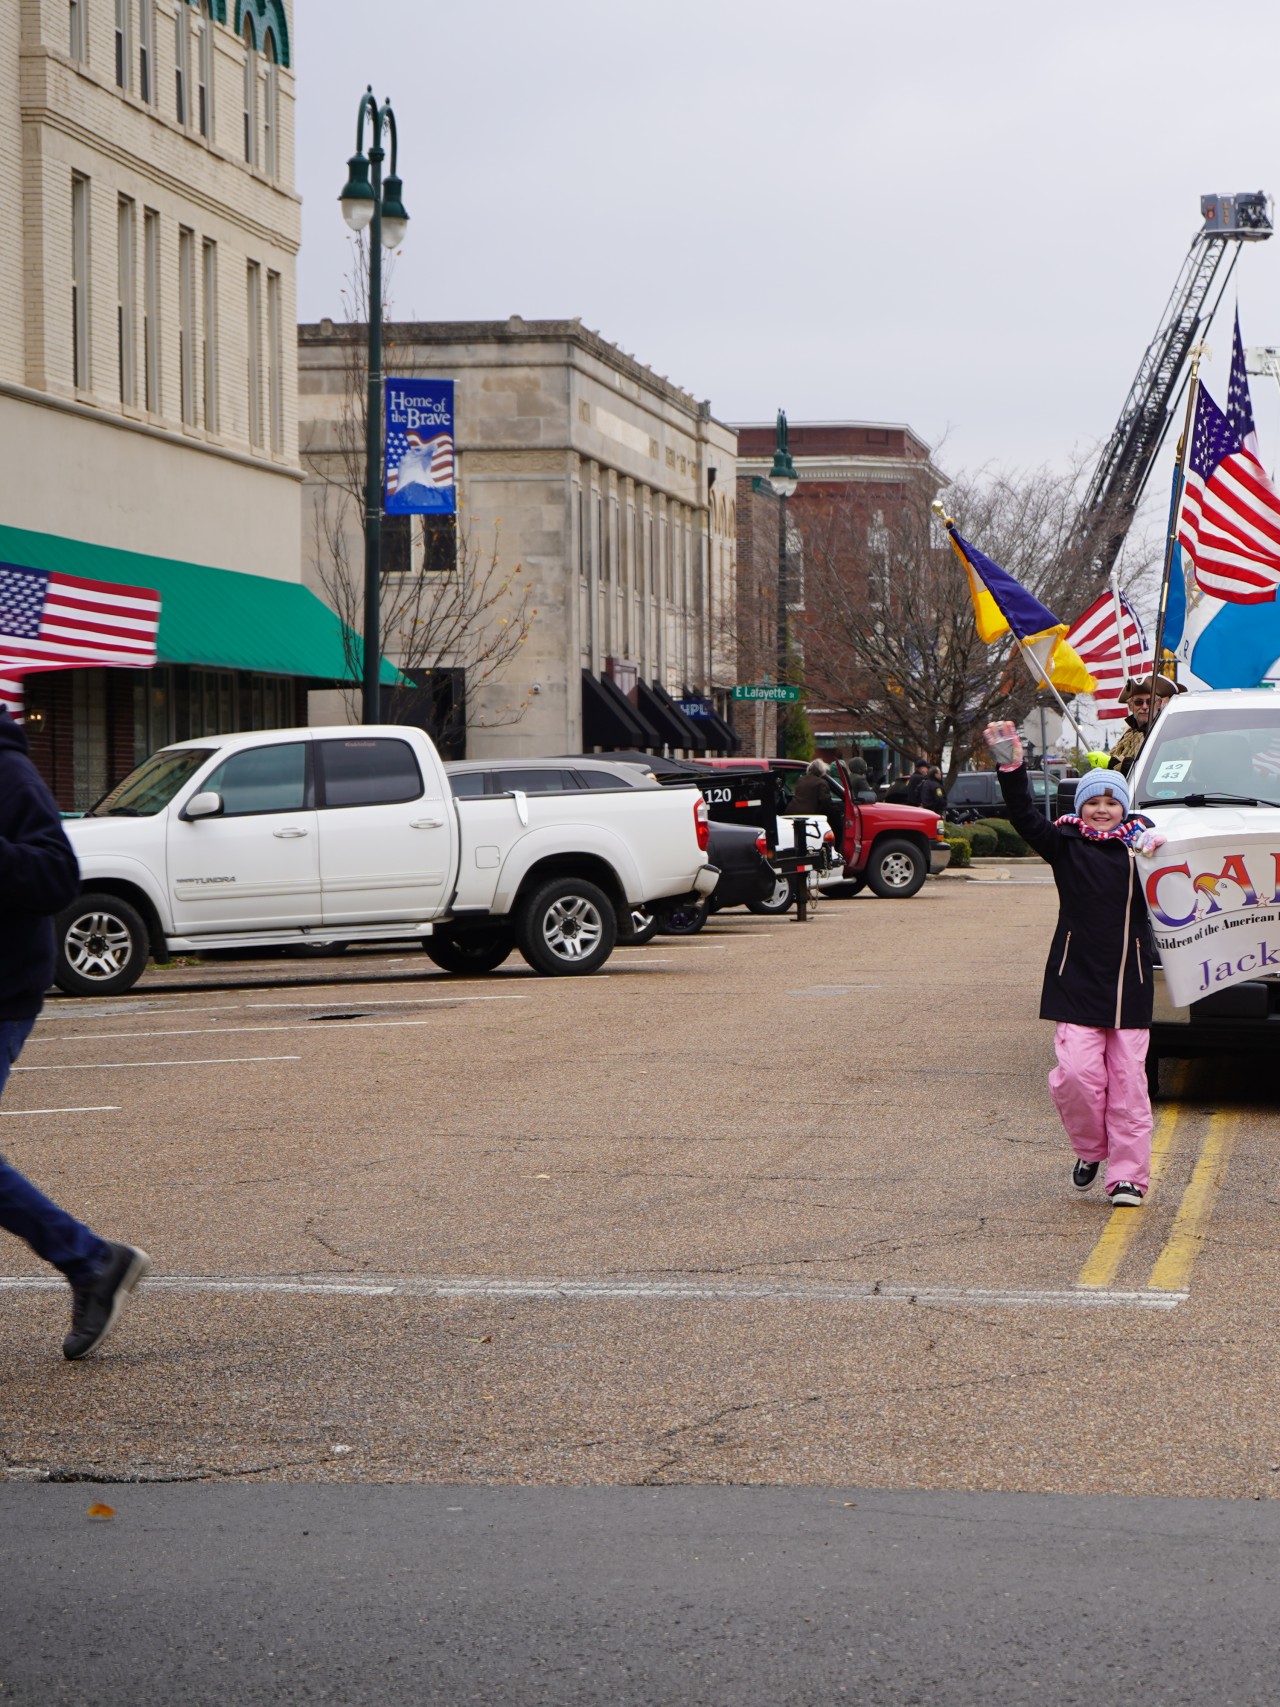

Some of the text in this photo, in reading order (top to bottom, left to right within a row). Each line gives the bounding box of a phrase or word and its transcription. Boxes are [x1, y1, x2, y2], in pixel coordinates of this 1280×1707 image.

[390, 391, 446, 412] Home of
[391, 408, 451, 429] the Brave
[736, 687, 742, 697] E
[745, 686, 787, 700] Lafayette
[704, 788, 732, 804] 120
[194, 876, 236, 885] TUNDRA
[1154, 936, 1193, 950] hildren
[1194, 927, 1203, 941] of
[1204, 924, 1220, 937] the
[1222, 914, 1275, 931] American
